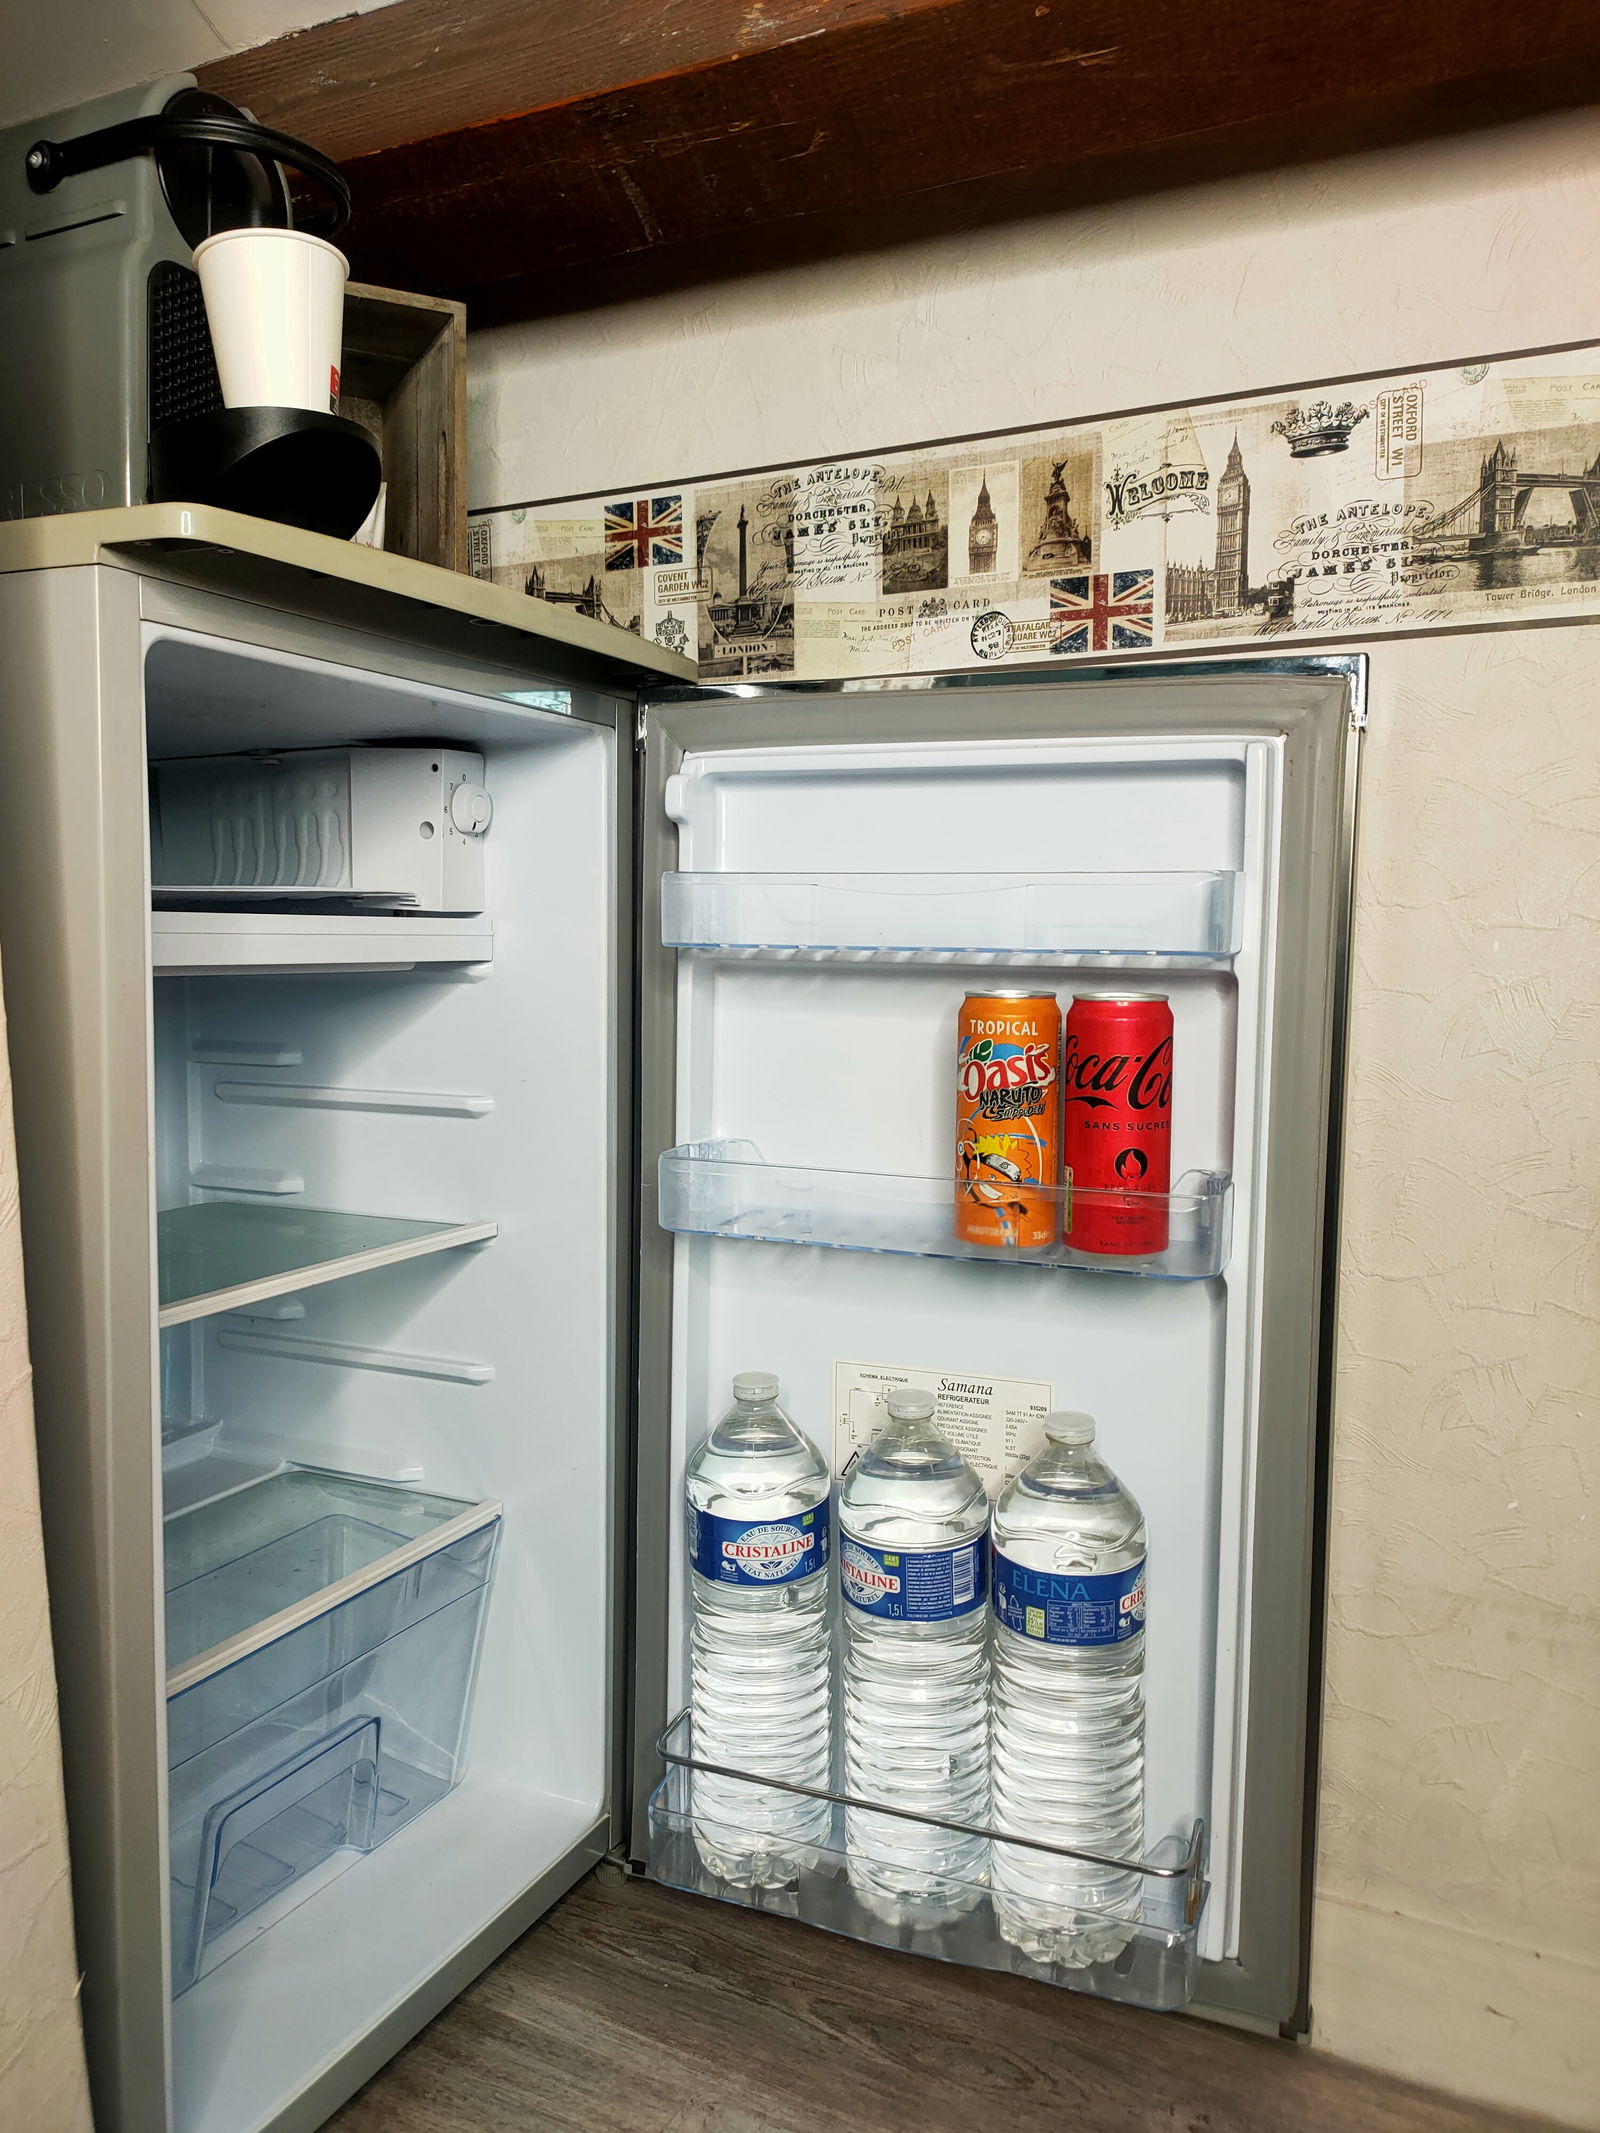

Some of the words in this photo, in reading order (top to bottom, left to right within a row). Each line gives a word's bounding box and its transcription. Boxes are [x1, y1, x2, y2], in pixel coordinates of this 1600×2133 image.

[1549, 384, 1573, 393] POST
[1391, 395, 1404, 438] STREET
[1405, 394, 1418, 441] OXFORD
[1391, 447, 1404, 466] W1
[773, 478, 801, 498] THE
[1106, 472, 1209, 515] WELCOME
[772, 522, 837, 540] JAMES
[1296, 514, 1329, 534] THE
[473, 529, 481, 563] STREET
[480, 529, 489, 565] OXFORD
[1292, 557, 1372, 579] JAMES
[658, 572, 688, 583] COVENT
[658, 582, 690, 593] GARDEN
[691, 579, 709, 590] WC2
[1485, 592, 1515, 602] Tower
[1561, 584, 1597, 595] London
[827, 608, 843, 616] POST
[849, 608, 867, 616] CARD
[879, 606, 914, 618] POST
[953, 598, 991, 610] CARD
[873, 622, 898, 632] ADDRESS
[934, 617, 960, 625] WRITTEN
[891, 633, 917, 650] POST
[1007, 631, 1038, 642] SQUARE
[1040, 630, 1057, 639] WC2
[970, 1020, 1039, 1036] TROPICAL
[963, 1043, 1052, 1102] Oasis
[980, 1086, 1043, 1109] NARUTO
[1084, 1120, 1120, 1131] SANS
[859, 1372, 879, 1380] SCHEMA
[880, 1374, 909, 1383] ELECTRIQUE
[937, 1377, 993, 1396] Samana
[937, 1393, 990, 1405] REFRIGERATEUR
[937, 1409, 969, 1417] ALIMENTATION
[969, 1412, 992, 1420] ASSIGNEE
[937, 1423, 964, 1431] FREQUENCE
[954, 1438, 981, 1447] CLIMATIQUE
[741, 1530, 756, 1542] EAU
[770, 1525, 799, 1538] SOURCE
[724, 1534, 813, 1558] CRISTALINE
[743, 1563, 761, 1577] ETAT
[764, 1558, 799, 1578] NATUREL
[1012, 1569, 1090, 1601] ELENA
